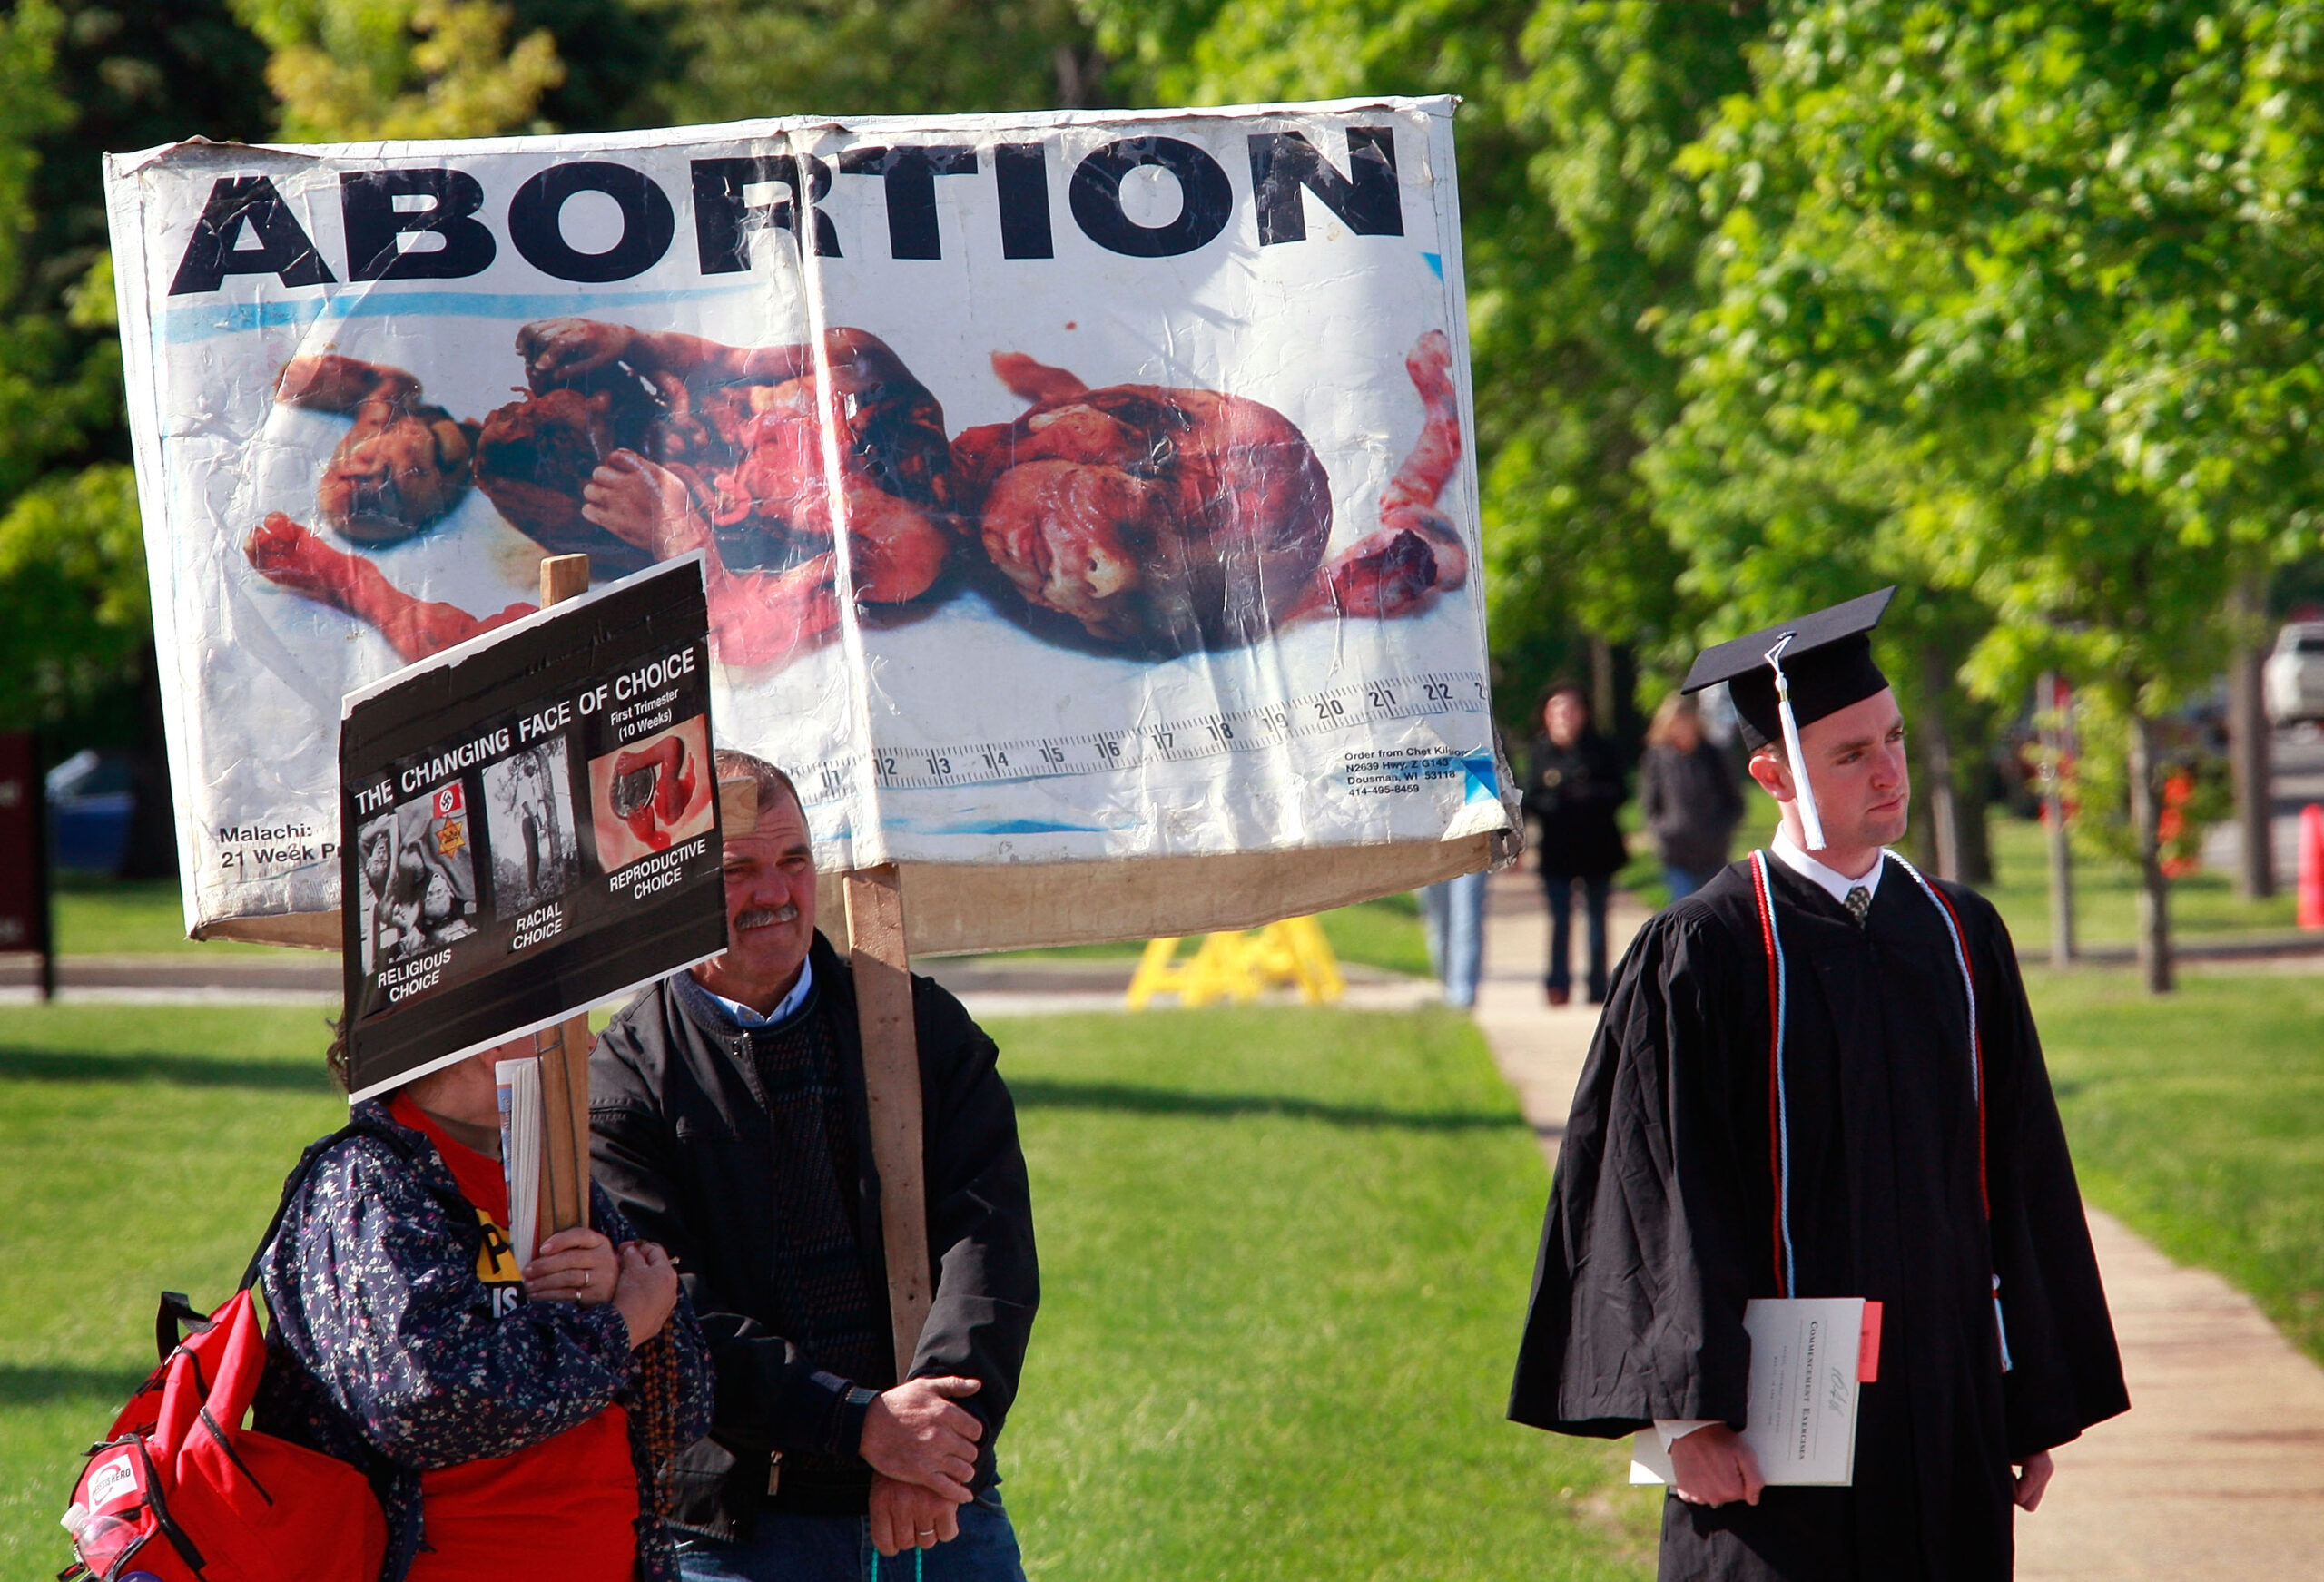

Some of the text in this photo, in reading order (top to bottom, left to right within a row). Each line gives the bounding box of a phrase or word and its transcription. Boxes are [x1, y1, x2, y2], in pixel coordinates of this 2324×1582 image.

[167, 126, 1404, 297] ABORTION
[610, 688, 679, 726] First Trimester
[355, 647, 695, 815] THE CHANGING FACE OF CHOICE
[618, 709, 673, 742] (10 Weeks)
[872, 758, 897, 775] 12
[926, 758, 951, 774] 13
[982, 752, 1009, 769] 14
[1039, 742, 1065, 763] 15
[1095, 741, 1120, 759] 16
[1152, 732, 1173, 750] 17
[1206, 722, 1234, 741] 18
[1261, 713, 1289, 732] 19
[1314, 699, 1344, 720] 20
[1368, 690, 1396, 708] 21
[1423, 683, 1453, 701] 22
[1344, 751, 1374, 761] Order
[1378, 748, 1403, 758] from
[1406, 747, 1432, 757] Chet
[1346, 762, 1379, 772] N2639
[1411, 760, 1419, 769] Z
[1422, 758, 1450, 768] G143
[1347, 770, 1456, 785] Dousman, WI 53118
[1348, 784, 1420, 796] 414-495-8459
[220, 823, 312, 843] Malachi:
[222, 843, 341, 869] 21 Week P
[609, 838, 707, 892] REPRODUCTIVE
[634, 867, 683, 899] CHOICE
[515, 902, 563, 933] RACIAL
[512, 918, 563, 950] CHOICE
[378, 948, 452, 988] RELIGIOUS
[389, 969, 440, 1003] CHOICE
[1803, 1321, 1818, 1403] COMMENCEMENT
